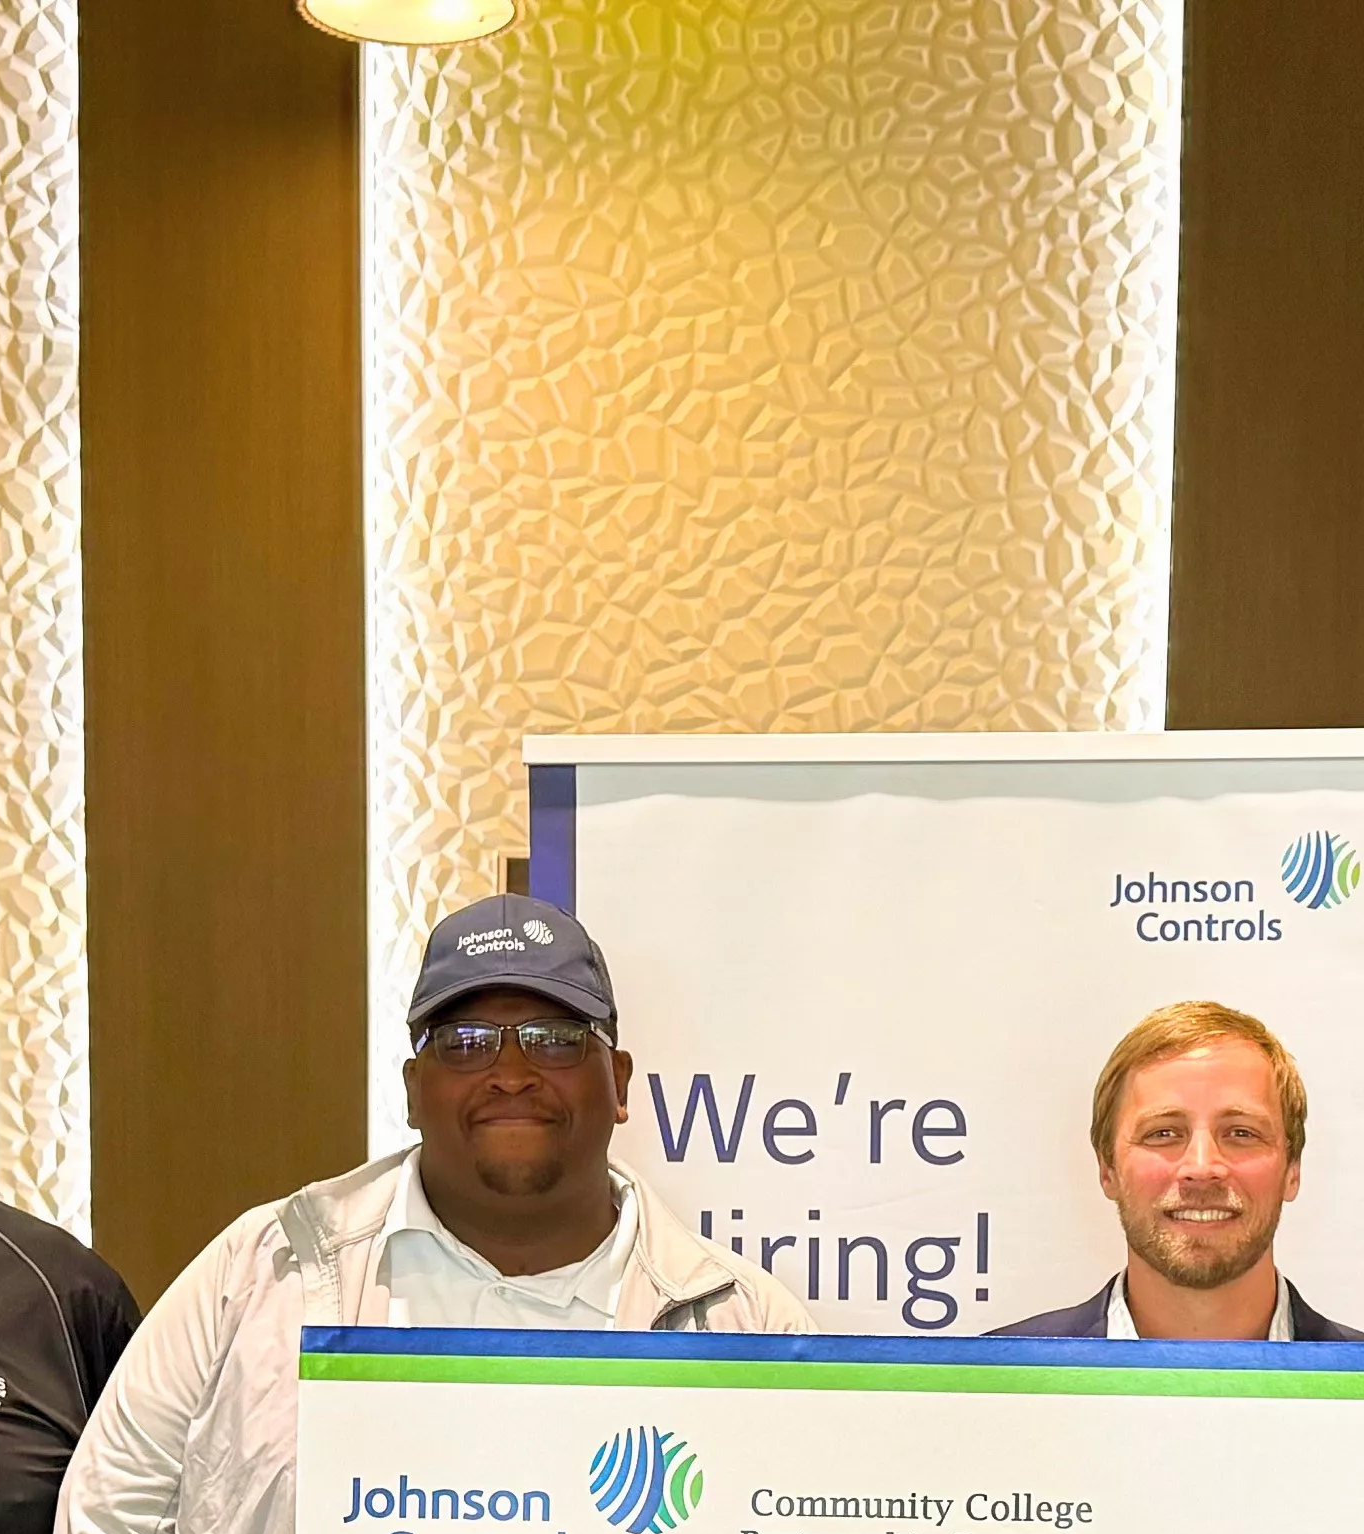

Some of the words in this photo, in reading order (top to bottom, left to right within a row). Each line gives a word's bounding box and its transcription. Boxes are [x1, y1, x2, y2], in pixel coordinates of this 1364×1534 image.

[1110, 871, 1254, 908] Johnson
[457, 927, 513, 951] Johnson
[1136, 909, 1283, 943] Controls
[466, 938, 526, 957] Controls
[647, 1072, 967, 1166] We're
[700, 1209, 989, 1330] iring!
[343, 1474, 551, 1524] Johnson
[751, 1488, 954, 1526] Community
[965, 1490, 1093, 1530] College
